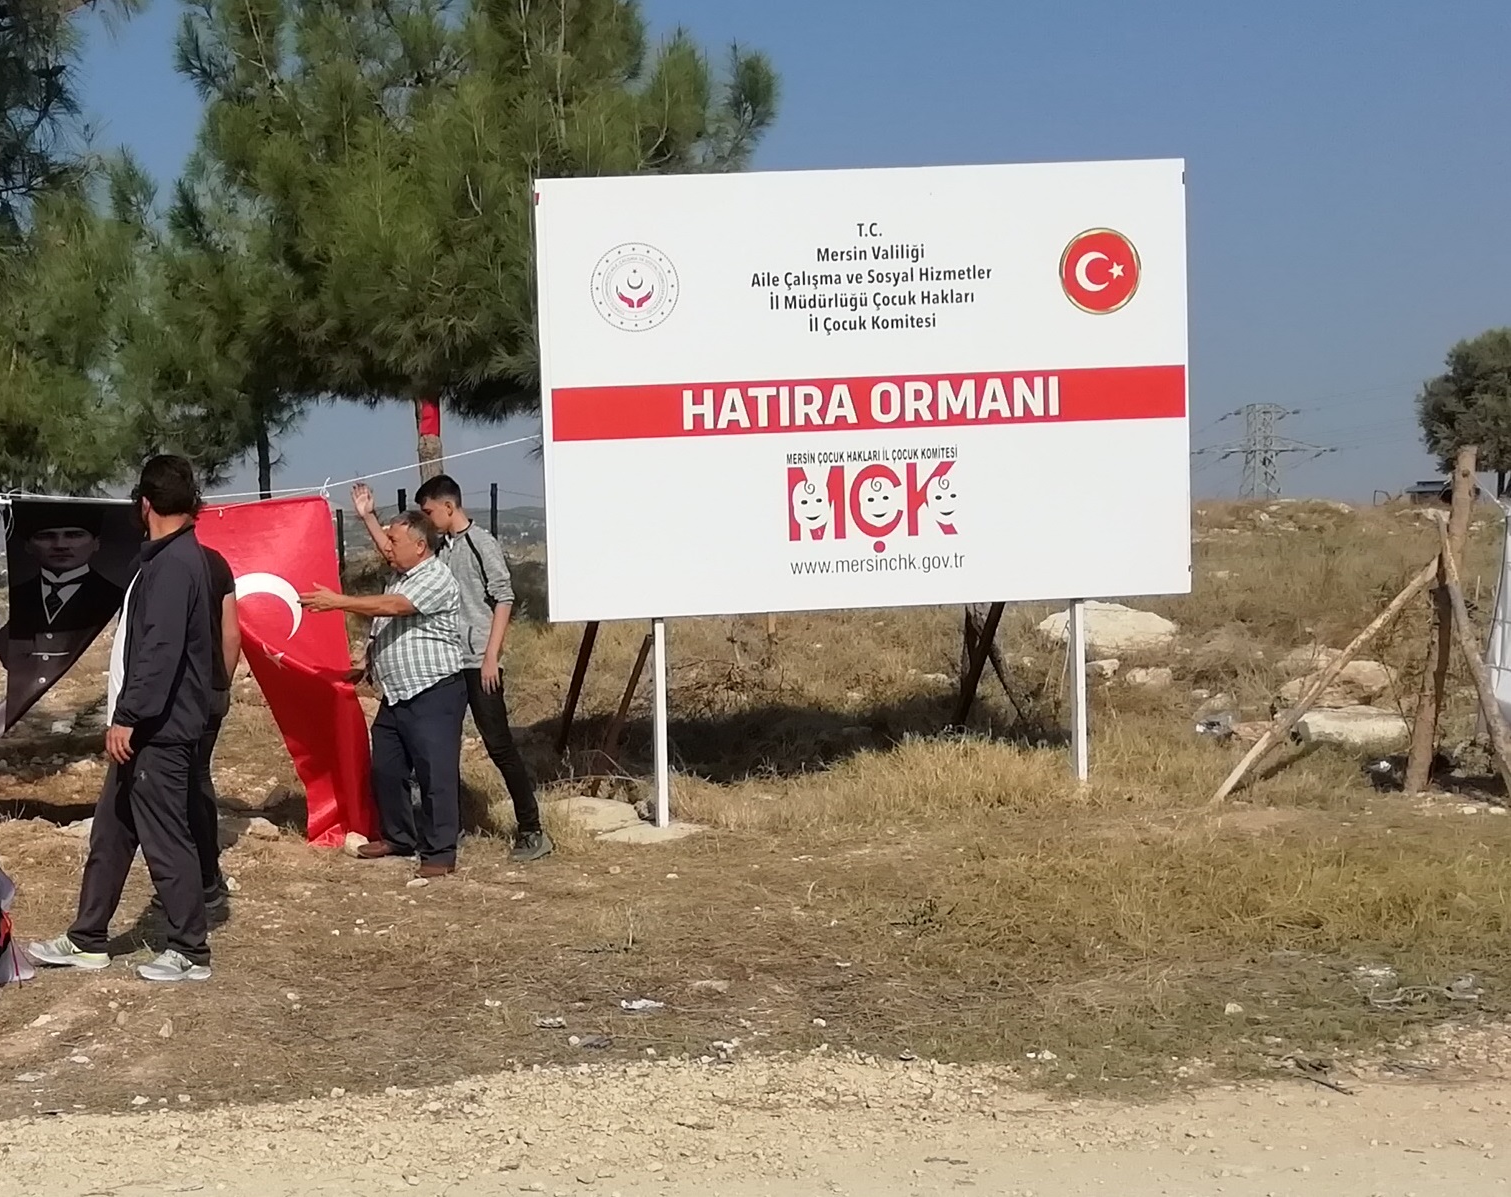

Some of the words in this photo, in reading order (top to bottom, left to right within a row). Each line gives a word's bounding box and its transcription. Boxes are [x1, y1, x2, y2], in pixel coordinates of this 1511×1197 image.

[856, 222, 883, 238] T.C.
[816, 245, 868, 262] Mersin
[871, 243, 925, 263] Valiliği
[751, 271, 780, 287] Aile
[784, 271, 842, 291] Çalışma
[846, 272, 864, 285] ve
[867, 266, 914, 288] Sosyal
[919, 264, 992, 282] Hizmetler
[769, 291, 780, 310] İl
[784, 292, 868, 312] Müdürlüğü
[872, 290, 917, 311] Çocuk
[921, 288, 975, 305] Hakları
[808, 313, 819, 332] İl
[823, 315, 867, 335] Çocuk
[871, 312, 937, 330] Komitesi
[682, 383, 859, 431] HATIRA
[869, 375, 1060, 423] ORMANI
[786, 450, 816, 465] MERSİN
[817, 450, 845, 466] ÇOCUK
[846, 449, 881, 463] HAKLARI
[882, 446, 890, 461] İL
[891, 448, 919, 464] ÇOCUK
[920, 443, 958, 459] KOMİTESİ
[790, 552, 965, 575] www.mersinchk.gov.tr
